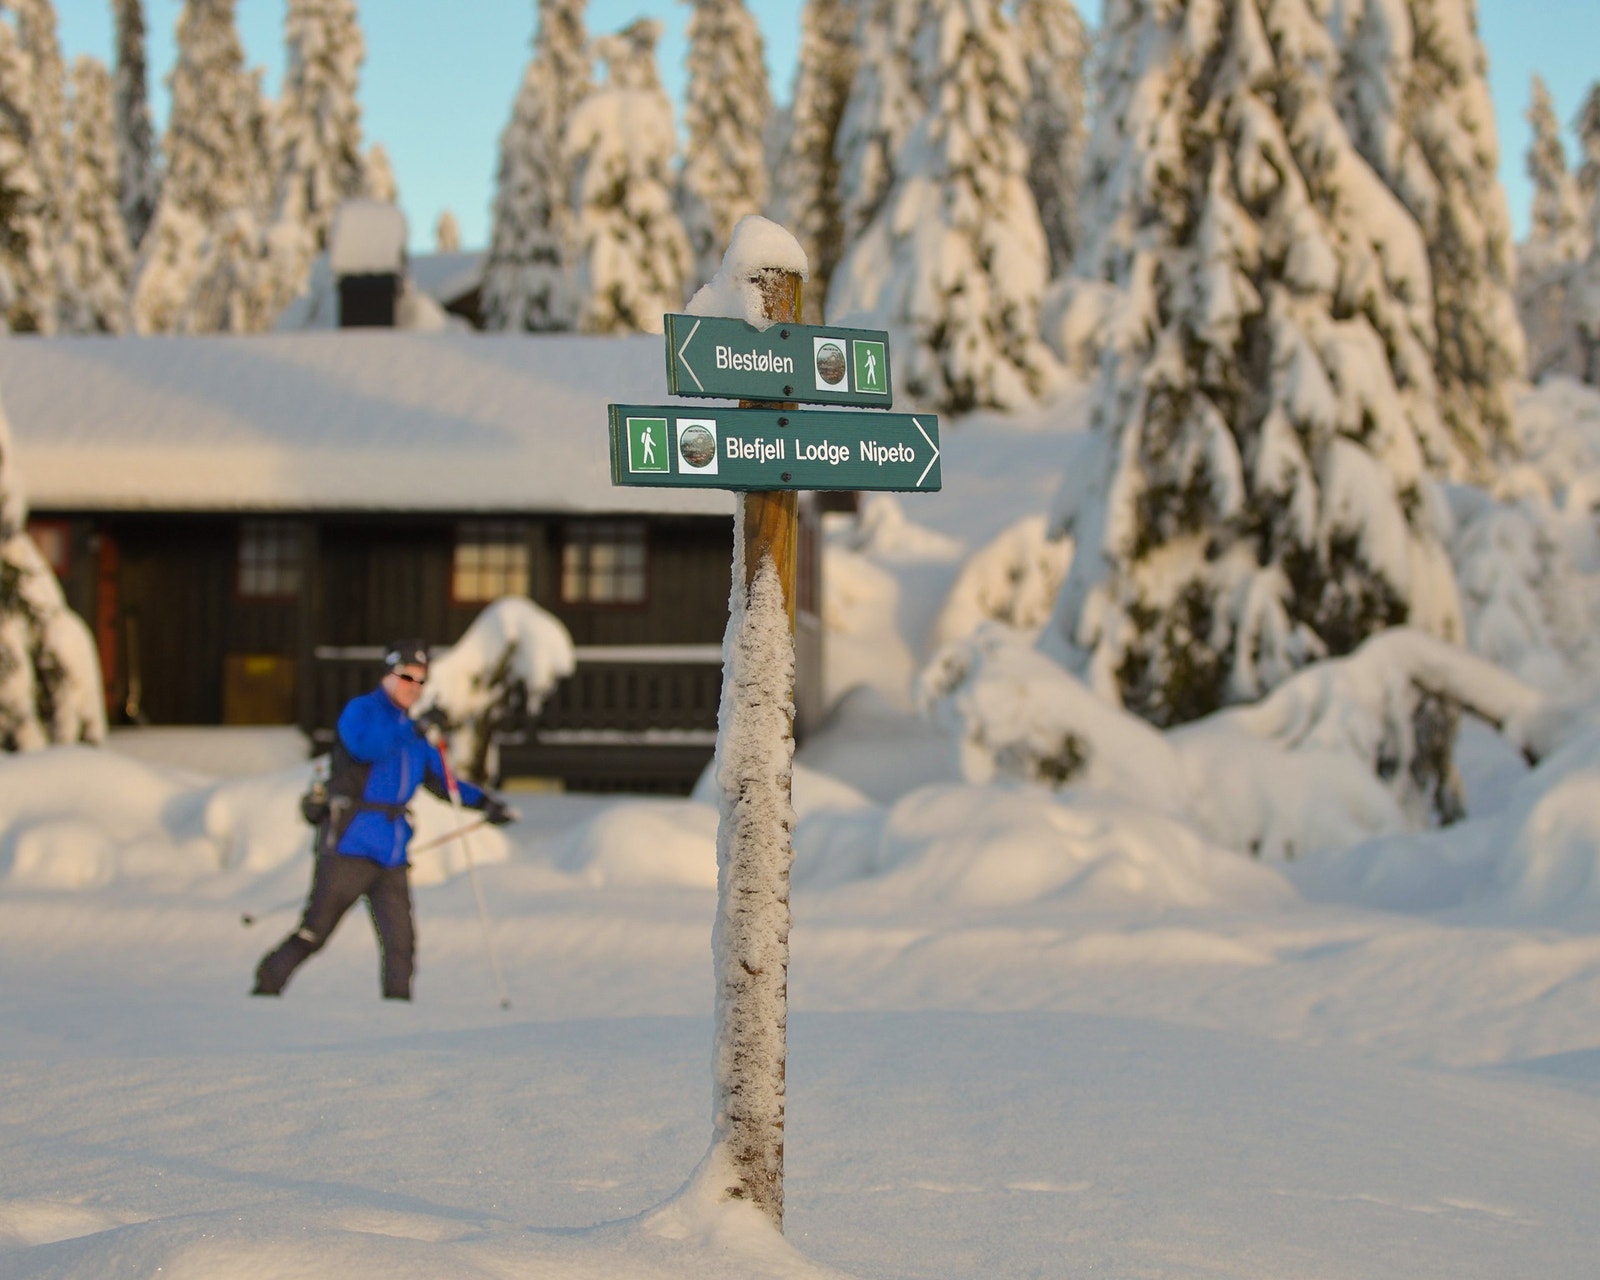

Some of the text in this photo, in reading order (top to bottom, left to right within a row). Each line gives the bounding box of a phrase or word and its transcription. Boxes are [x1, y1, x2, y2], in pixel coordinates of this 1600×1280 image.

[715, 345, 794, 374] Blestølen
[726, 436, 915, 467] Blefjell Lodge Nipeto
